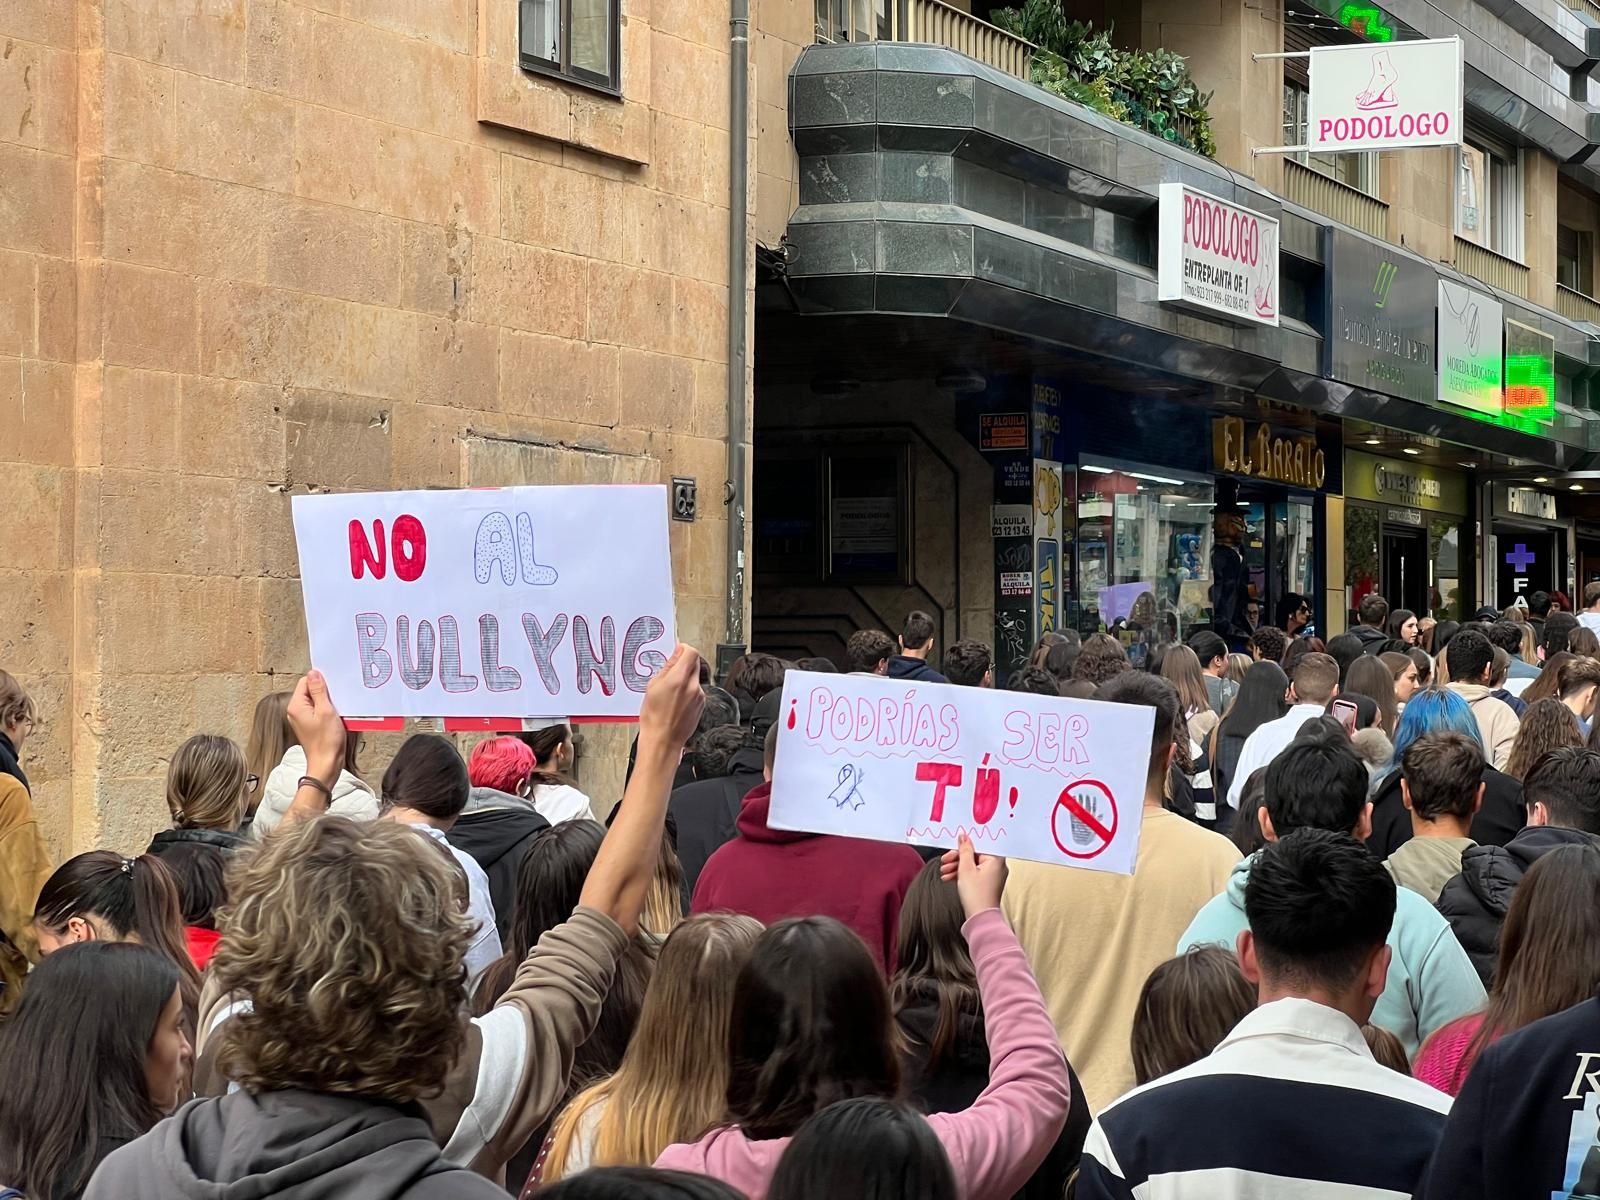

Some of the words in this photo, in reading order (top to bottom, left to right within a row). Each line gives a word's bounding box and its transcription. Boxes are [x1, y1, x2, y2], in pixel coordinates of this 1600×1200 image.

[1319, 112, 1449, 142] PODOLOGO
[1184, 194, 1258, 267] PODOLOGO
[1185, 258, 1232, 290] ENTREPLANTA
[1234, 273, 1243, 294] OF.
[1245, 276, 1249, 296] 1
[1205, 288, 1213, 302] 217
[982, 416, 992, 427] SE
[993, 415, 1026, 426] ALQUILA
[1224, 415, 1252, 476] EL
[1003, 465, 1030, 473] VENDE
[676, 485, 696, 515] 65
[993, 517, 1026, 526] ALQUILA
[1004, 526, 1011, 535] 12
[1013, 526, 1020, 535] 13
[1022, 525, 1030, 535] 45
[348, 514, 427, 582] NO
[473, 511, 559, 586] AL
[1513, 578, 1529, 609] FA
[355, 613, 668, 696] BULLYNG
[1002, 710, 1090, 764] SER
[915, 752, 1019, 825] TÚ!
[1563, 1053, 1600, 1100] R
